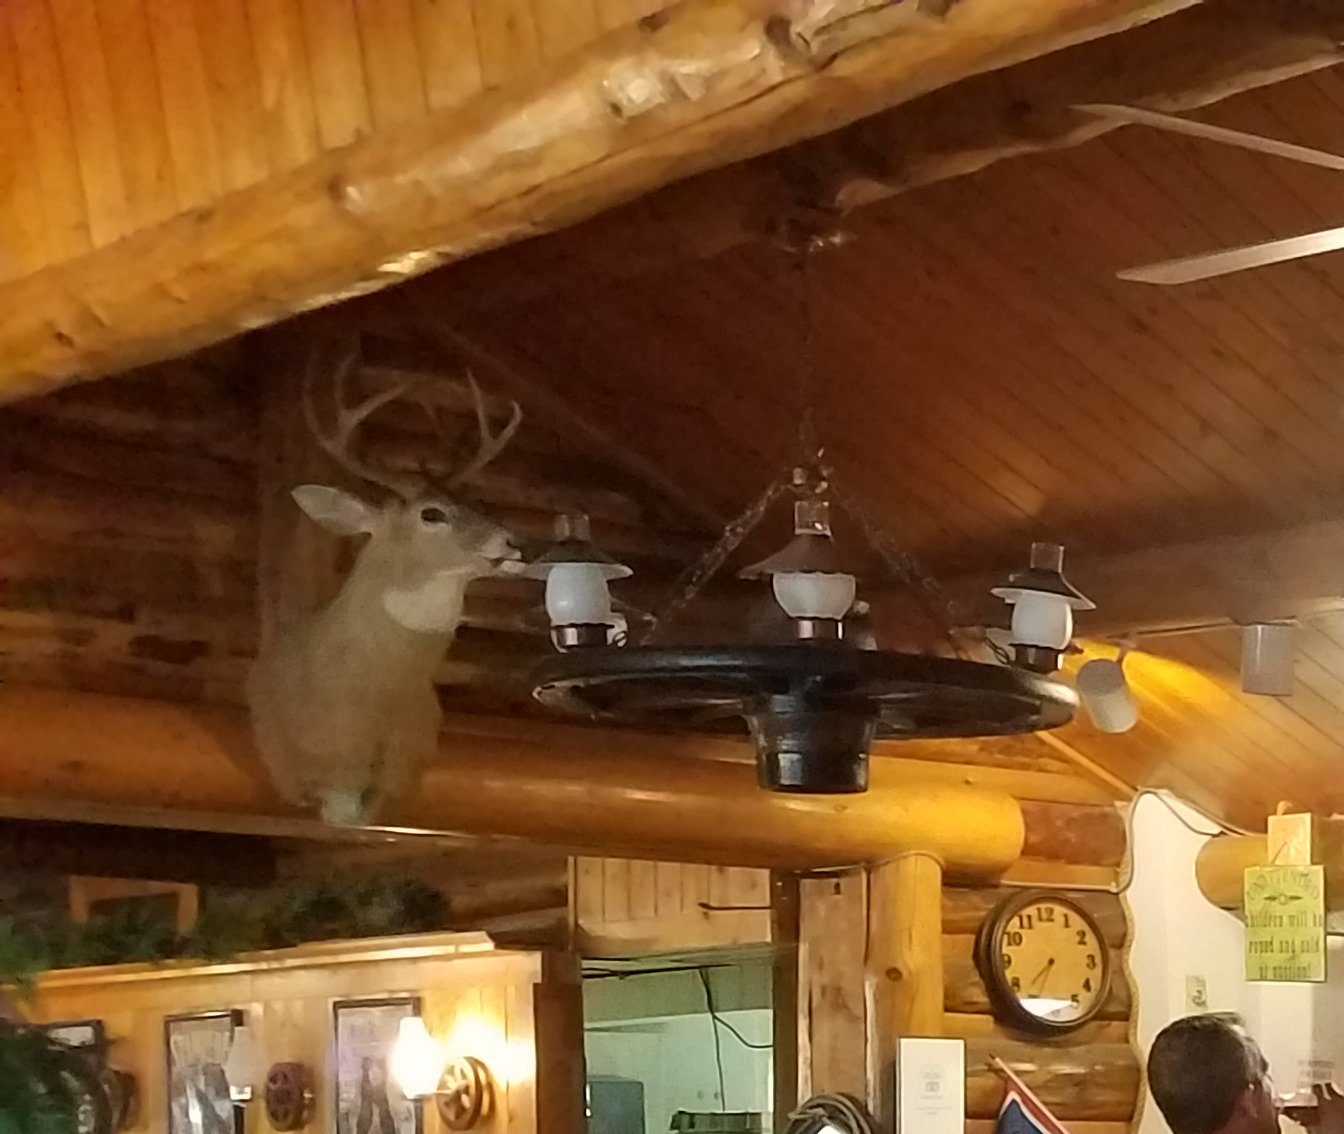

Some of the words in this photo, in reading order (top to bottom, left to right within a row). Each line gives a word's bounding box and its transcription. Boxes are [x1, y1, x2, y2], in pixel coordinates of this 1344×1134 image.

[1018, 914, 1034, 930] 11
[1036, 907, 1055, 923] 12
[1062, 913, 1071, 929] 1
[1005, 931, 1023, 947] 10
[1076, 930, 1088, 945] 2
[1001, 954, 1012, 970] 9
[1086, 954, 1097, 970] 3
[1082, 977, 1092, 993] 4
